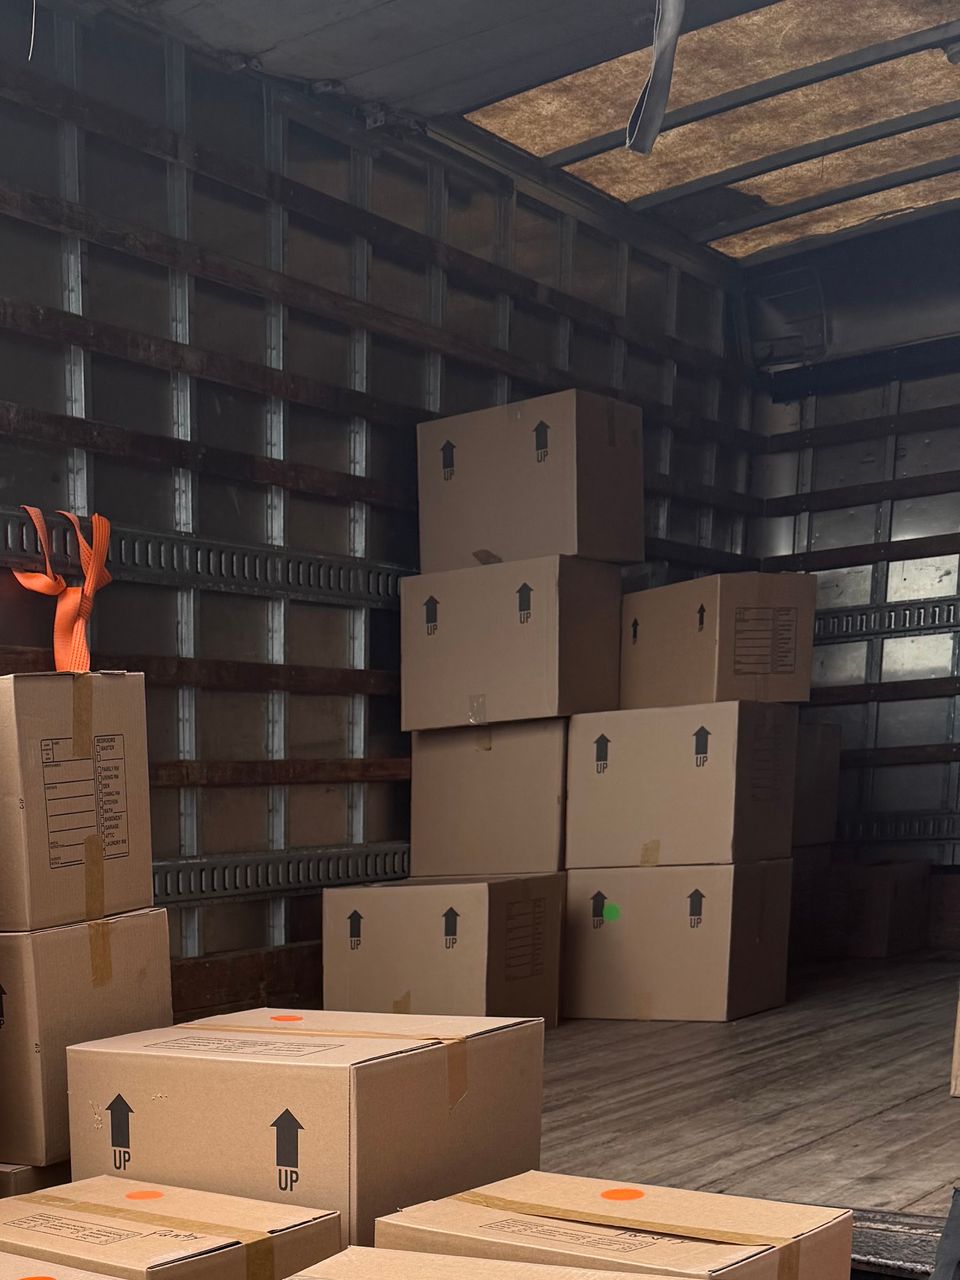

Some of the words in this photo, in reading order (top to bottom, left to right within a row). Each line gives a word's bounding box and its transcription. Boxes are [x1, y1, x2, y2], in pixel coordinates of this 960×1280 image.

[537, 450, 548, 463] UP
[520, 612, 531, 624] UP
[426, 624, 438, 636] UP
[596, 762, 608, 774] UP
[696, 756, 708, 768] UP
[592, 918, 604, 929] UP
[690, 918, 702, 928] UP
[350, 939, 361, 950] UP
[445, 938, 457, 949] UP
[114, 1149, 130, 1170] UP
[278, 1169, 298, 1192] UP
